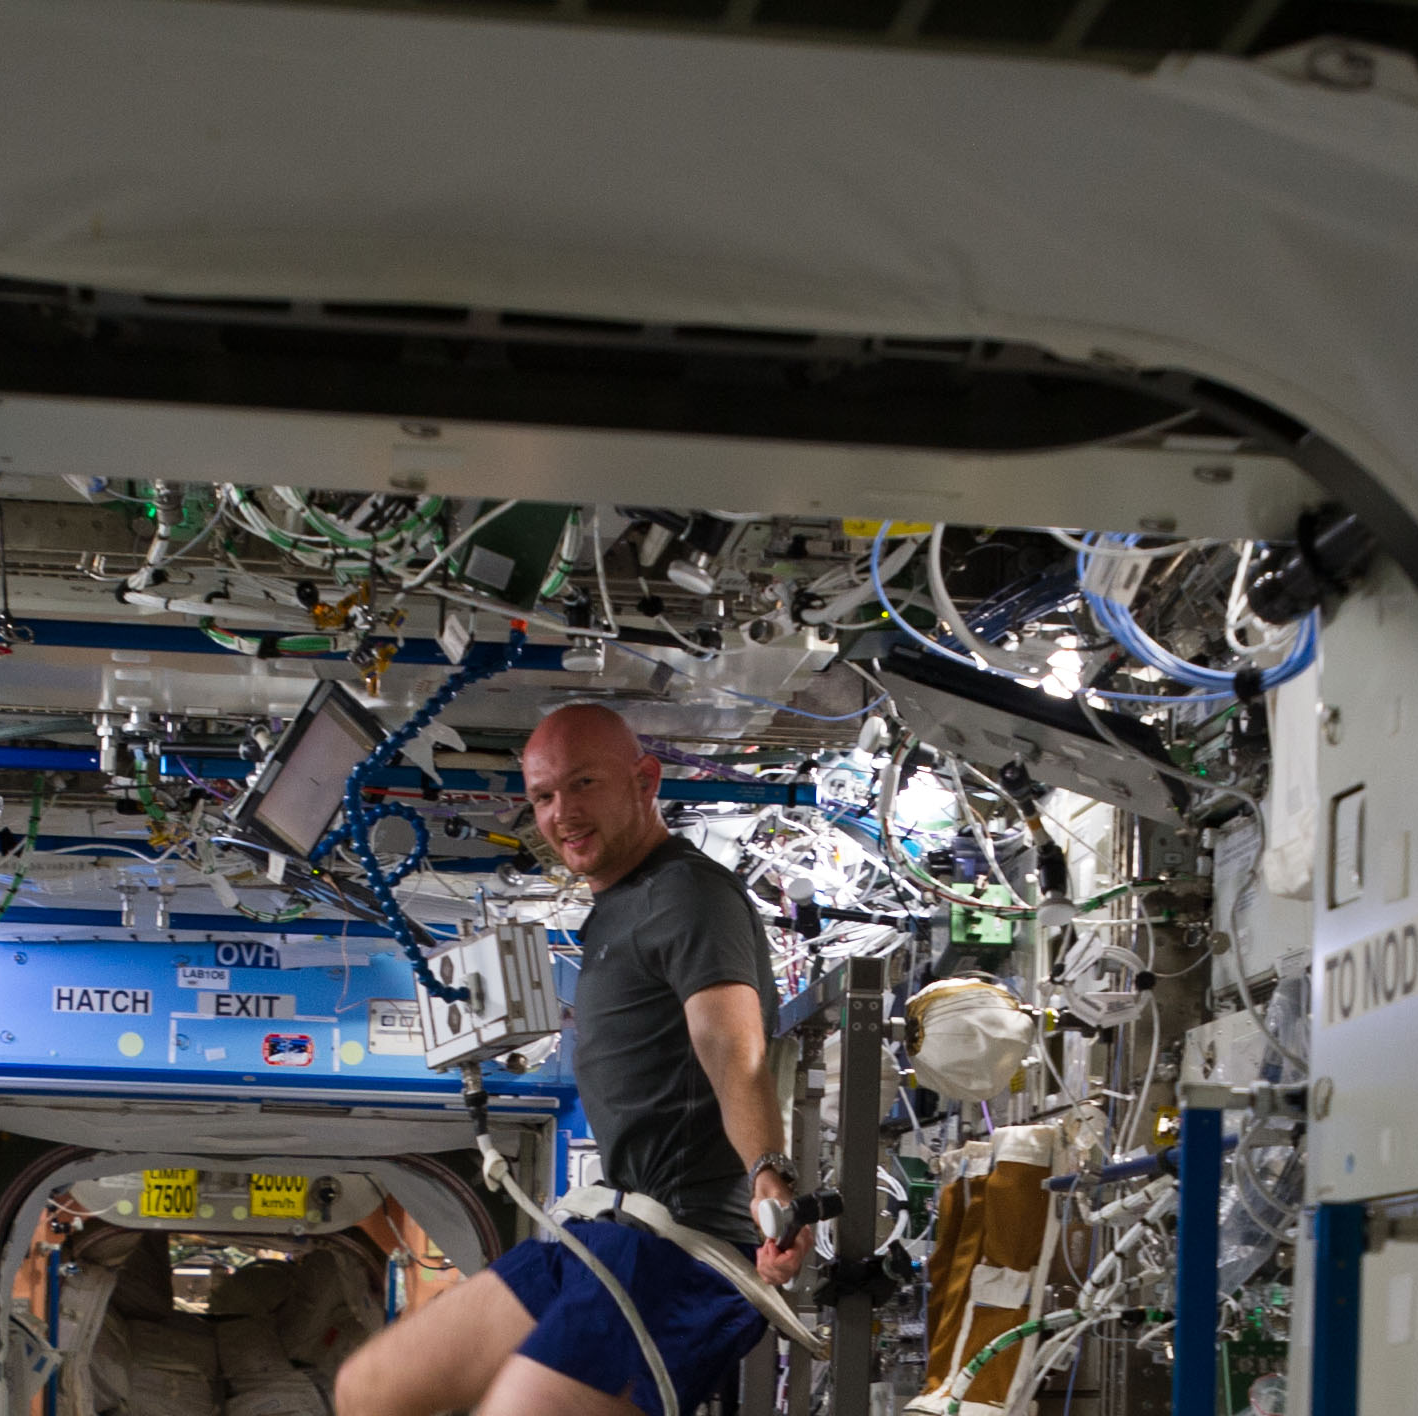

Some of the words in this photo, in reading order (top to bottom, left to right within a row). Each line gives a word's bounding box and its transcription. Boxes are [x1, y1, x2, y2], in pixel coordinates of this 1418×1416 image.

[216, 943, 279, 967] OVH
[1325, 950, 1356, 1024] TO
[56, 988, 149, 1013] HATCH
[215, 993, 281, 1018] EXIT
[146, 1184, 194, 1213] 17500
[261, 1197, 296, 1208] km/h
